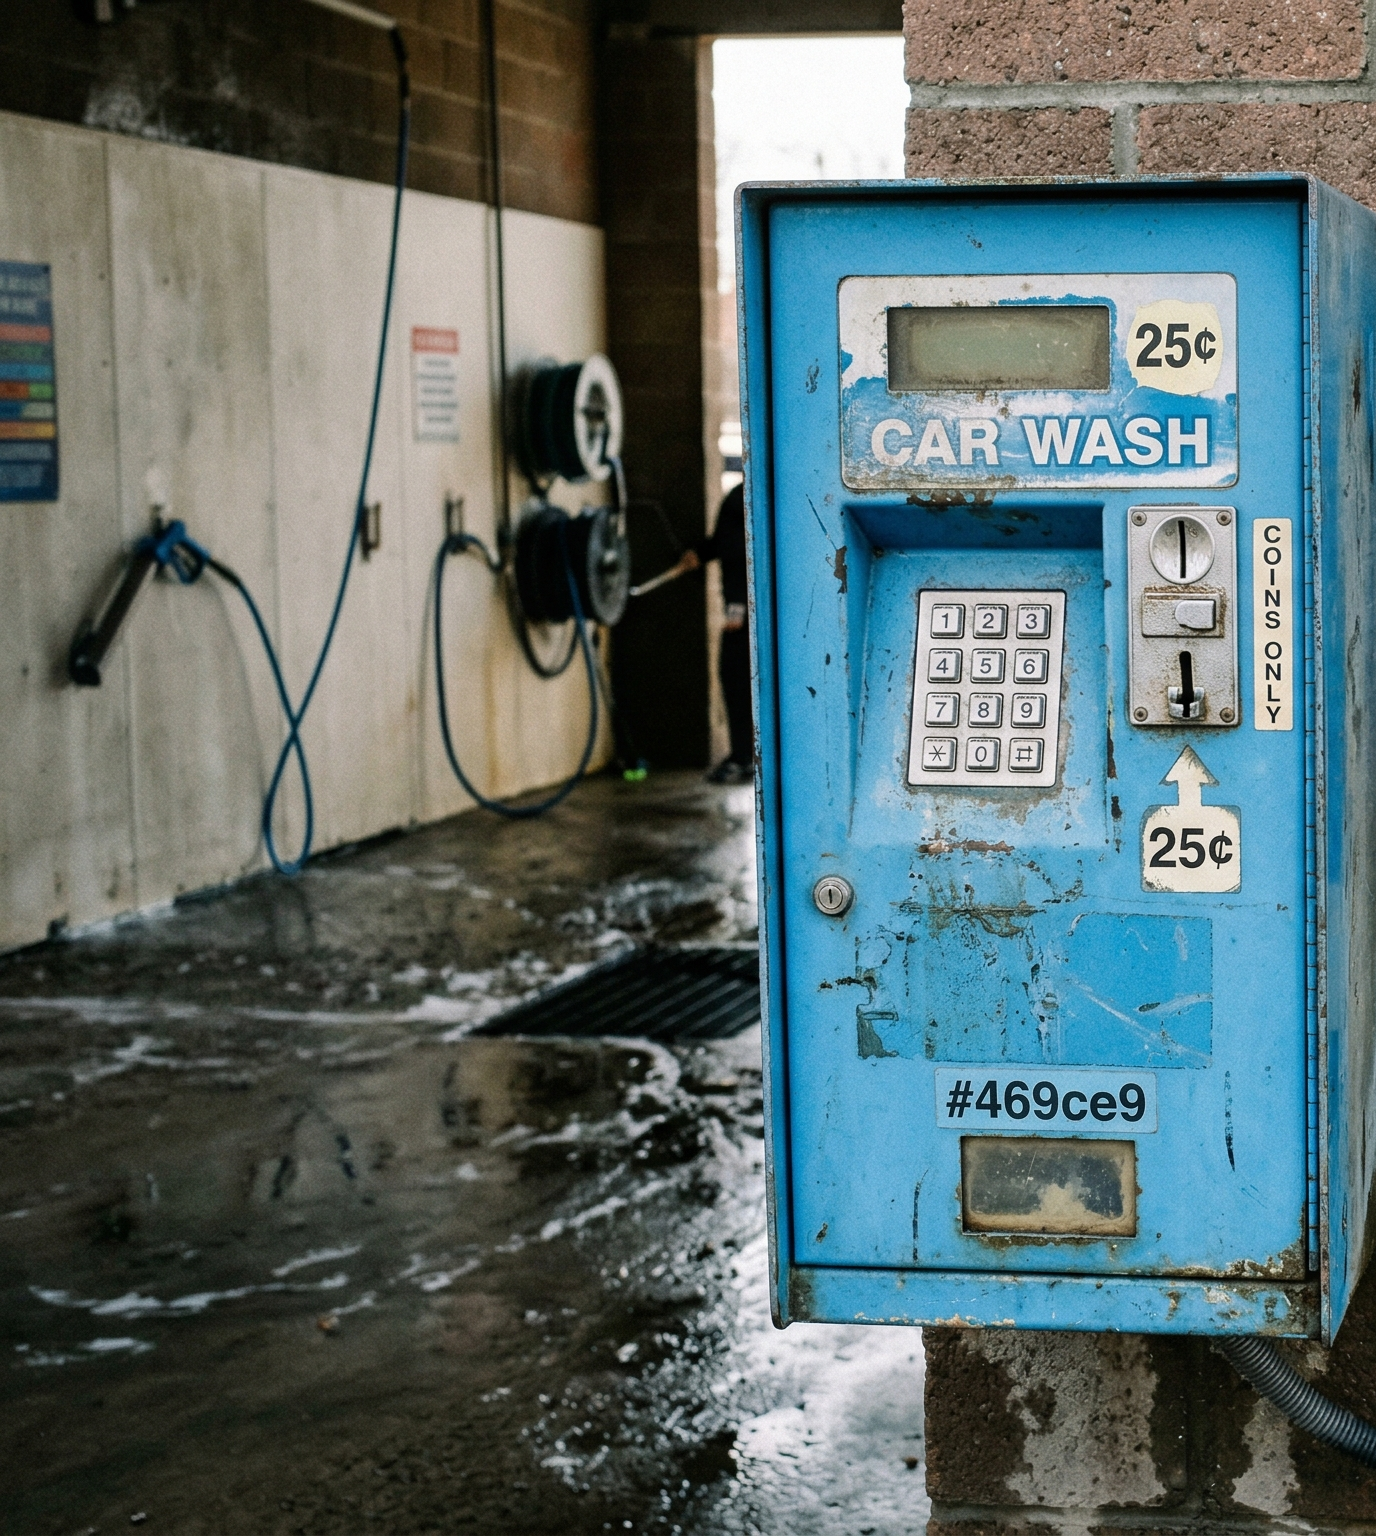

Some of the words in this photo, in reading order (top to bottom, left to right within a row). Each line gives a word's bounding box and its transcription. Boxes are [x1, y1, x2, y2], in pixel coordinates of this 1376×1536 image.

[1135, 323, 1217, 369] 25¢
[871, 418, 999, 466] CAR
[1022, 417, 1208, 466] WASH
[1263, 525, 1282, 630] COINS
[942, 613, 949, 629] 1
[983, 613, 995, 629] 2
[1025, 613, 1038, 630] 3
[936, 657, 949, 674] 4
[980, 657, 992, 674] 5
[1023, 658, 1036, 675] 6
[1264, 641, 1283, 724] ONLY
[935, 702, 947, 718] 7
[978, 702, 990, 718] 8
[1021, 703, 1033, 718] 9
[975, 746, 987, 762] 0
[1149, 827, 1233, 870] 25¢
[945, 1080, 1146, 1123] #469ce9
